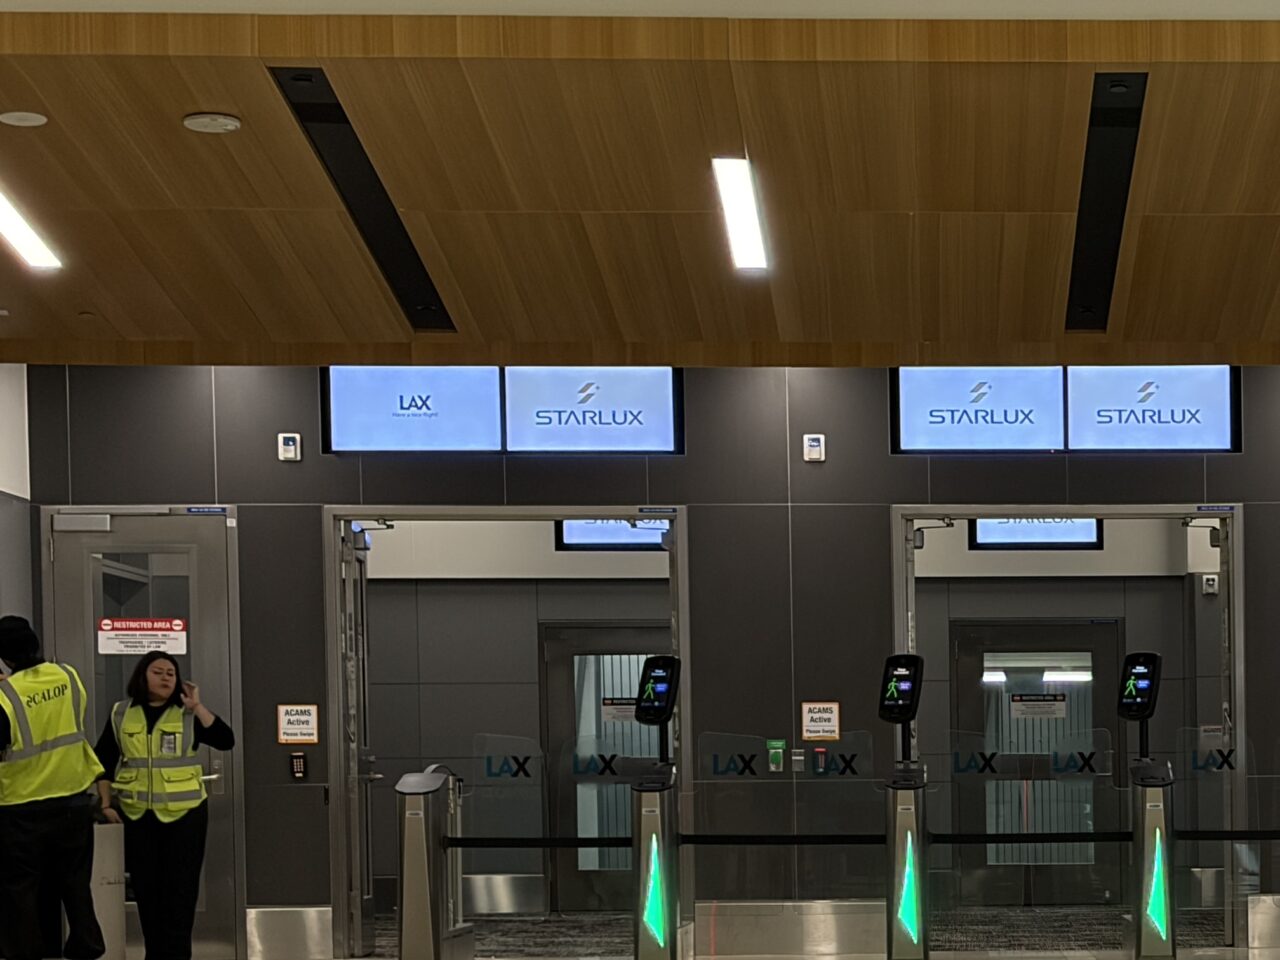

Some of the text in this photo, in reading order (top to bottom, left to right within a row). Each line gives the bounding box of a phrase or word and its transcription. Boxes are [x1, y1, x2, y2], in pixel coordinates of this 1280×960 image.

[399, 395, 432, 411] LAX
[535, 410, 644, 426] STARLUX
[928, 409, 1034, 425] STARLUX
[1096, 409, 1202, 425] STARLUX
[113, 621, 171, 629] RESTRICTED AREA
[285, 709, 311, 717] ACAMS
[808, 706, 833, 714] ACAMS
[286, 718, 310, 726] Active
[485, 755, 531, 778] LAX
[572, 754, 618, 776] LAX
[712, 753, 757, 776] LAX
[953, 751, 998, 773] LAX
[1052, 751, 1097, 773] LAX
[1191, 748, 1236, 770] LAX
